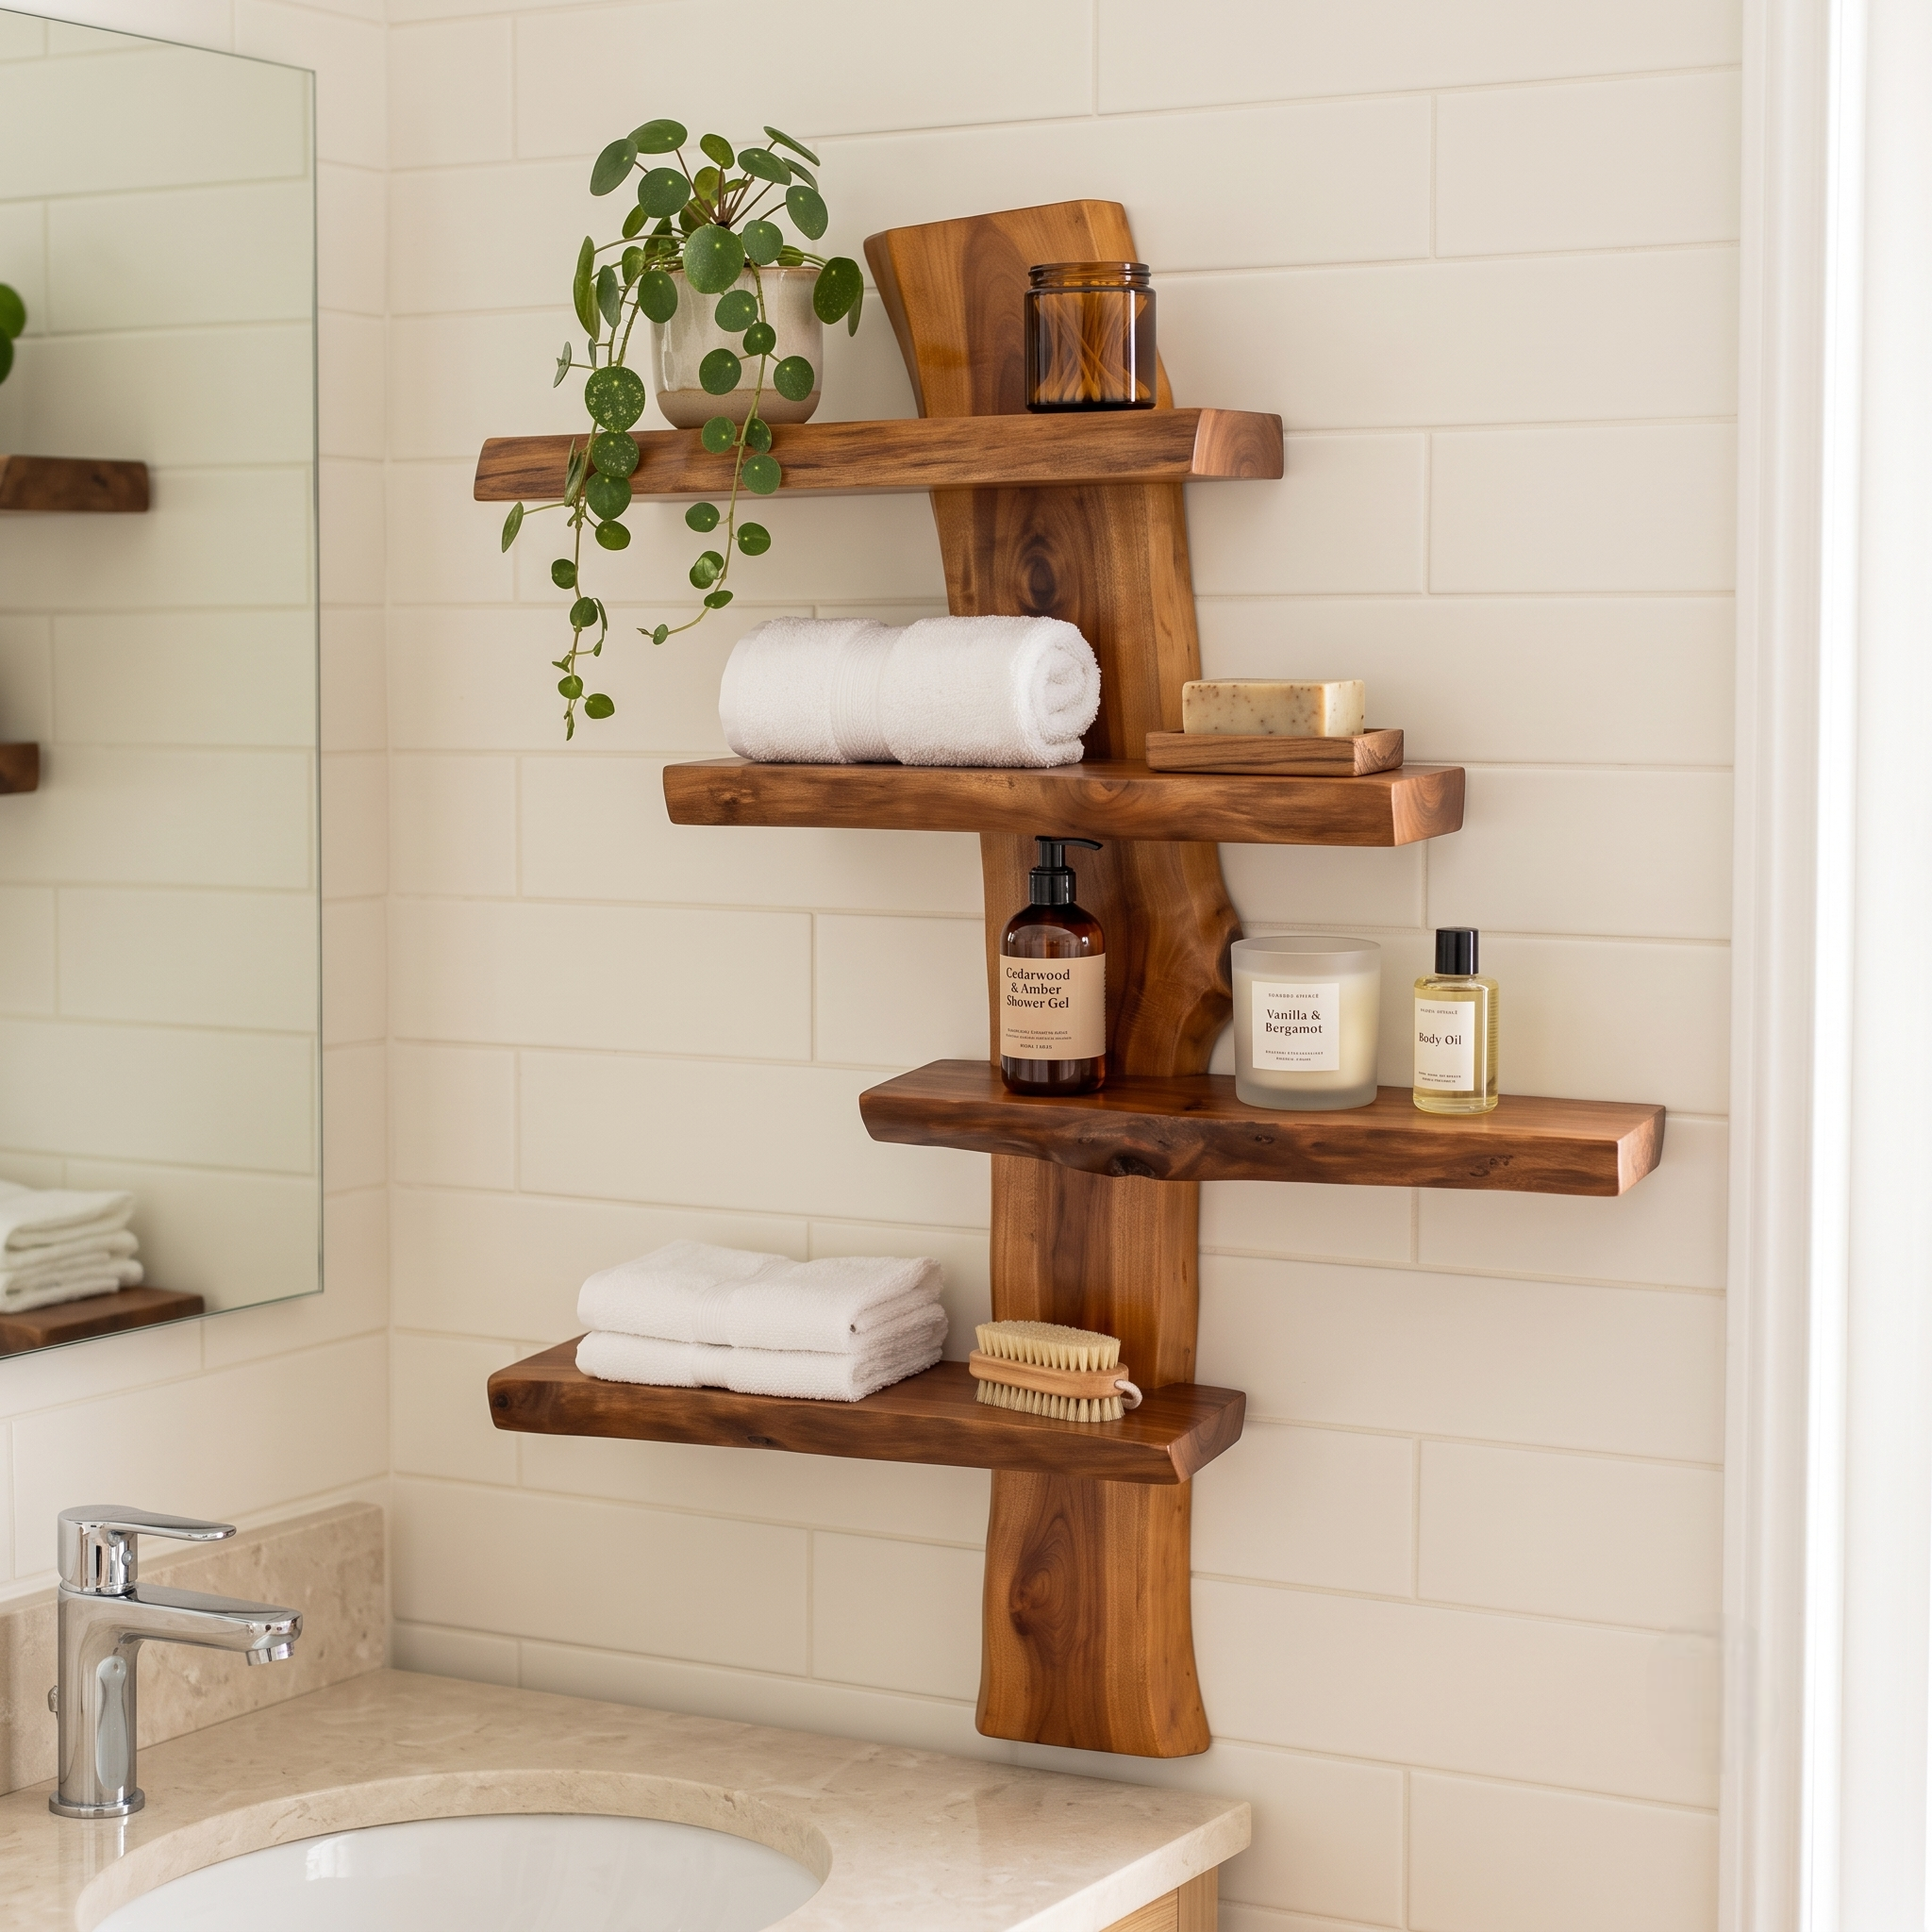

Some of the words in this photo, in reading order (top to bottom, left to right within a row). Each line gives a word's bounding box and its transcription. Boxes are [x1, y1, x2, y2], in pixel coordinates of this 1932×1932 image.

[1006, 967, 1071, 980] Cedarwood
[1010, 982, 1019, 993] &
[1021, 983, 1062, 994] Amber
[1007, 994, 1045, 1008] Shower
[1047, 996, 1070, 1008] Gel
[1266, 1008, 1307, 1020] Vanilla
[1310, 1009, 1322, 1021] &
[1265, 1022, 1323, 1037] Bergamot
[1419, 1032, 1441, 1047] Body
[1444, 1035, 1462, 1045] Oil
